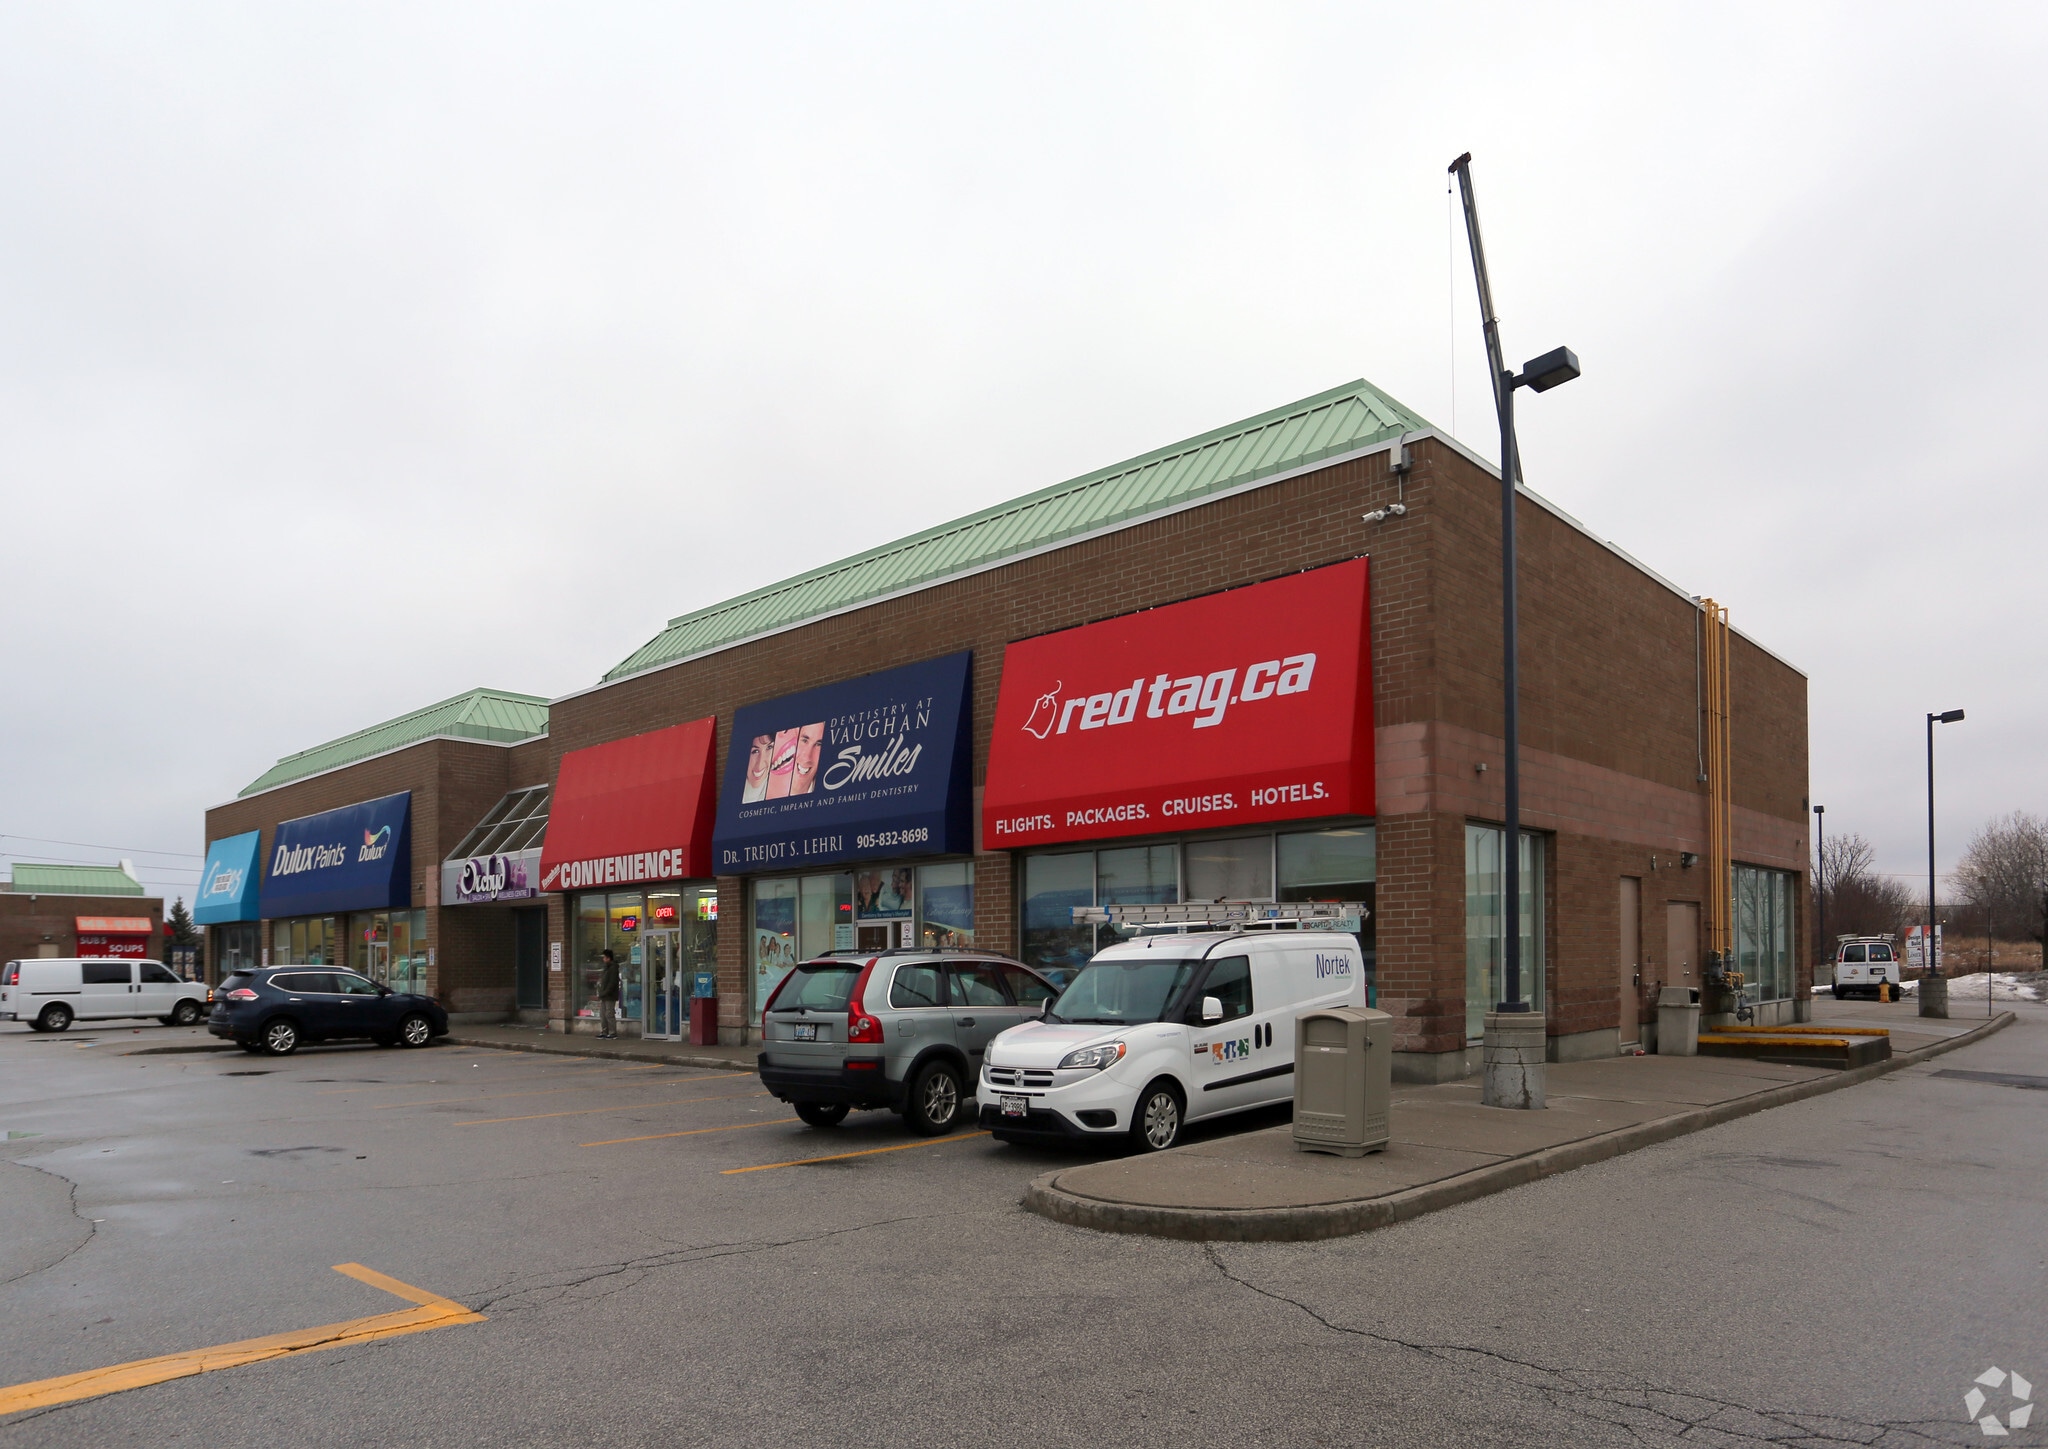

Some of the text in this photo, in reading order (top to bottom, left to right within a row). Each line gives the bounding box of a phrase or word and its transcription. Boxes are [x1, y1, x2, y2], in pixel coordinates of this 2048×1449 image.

[829, 709, 932, 745] VAUGHAN
[830, 697, 934, 728] DENTISTRY AT
[823, 733, 923, 790] Smiles
[738, 784, 920, 820] COSMETIC, IMPLANT AND FAMILY DENTISTRY
[996, 781, 1330, 834] FLIGHTS. PACKAGES. CRUISES. HOTELS.
[744, 843, 786, 863] TREJOT
[790, 842, 799, 856] S.
[804, 835, 843, 855] LEHRI
[856, 827, 929, 849] 905-832-8698
[272, 843, 347, 876] Dulux Paints
[358, 845, 384, 862] Dulux
[560, 848, 683, 888] CONVENIENCE
[656, 907, 673, 918] OPEN
[80, 936, 107, 944] SUBS
[109, 944, 144, 952] SOUPS
[1316, 954, 1351, 979] Nortek
